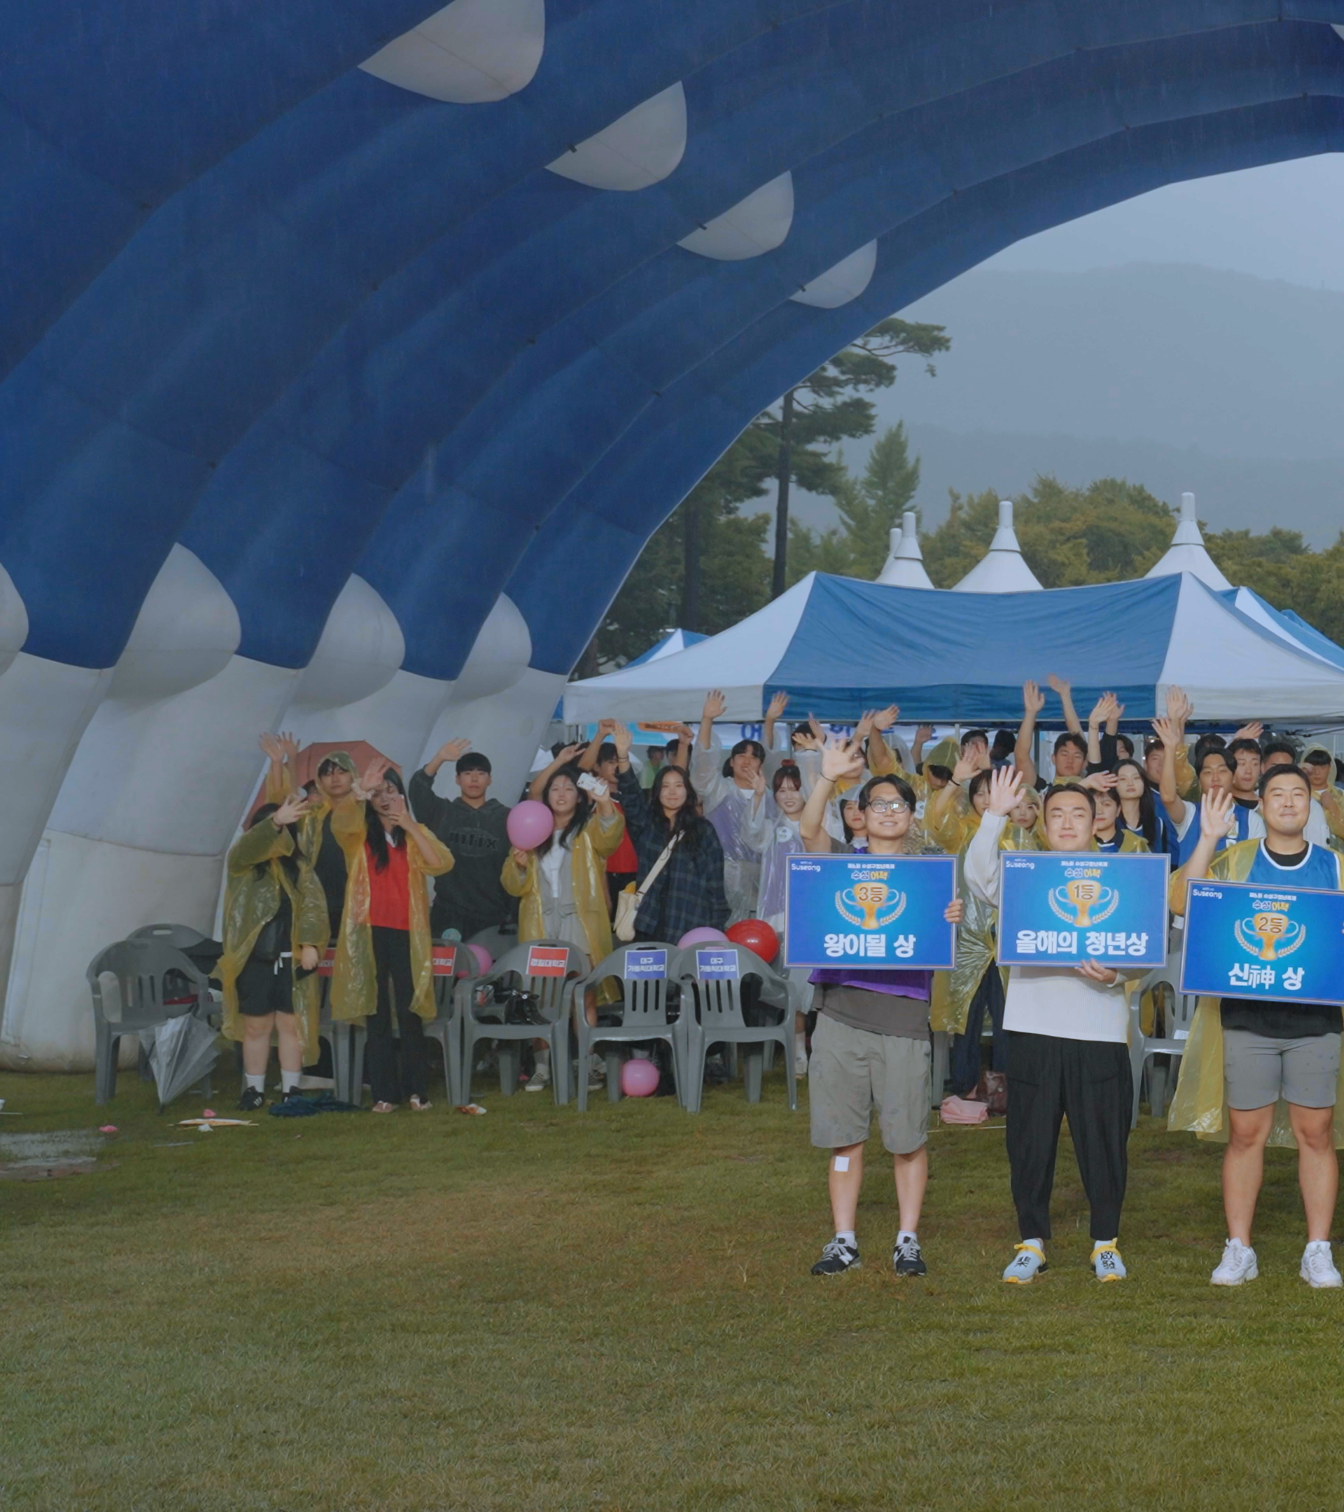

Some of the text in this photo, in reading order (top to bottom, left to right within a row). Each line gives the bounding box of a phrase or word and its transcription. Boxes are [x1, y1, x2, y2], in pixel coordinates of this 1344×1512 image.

[791, 863, 821, 872] Suseong
[1005, 861, 1035, 869] Suseong
[857, 886, 884, 903] 3등
[1073, 884, 1094, 900] 1등
[1193, 889, 1222, 899] Suseong
[1258, 916, 1283, 934] 2등
[824, 933, 916, 958] 왕이될 상
[1016, 930, 1148, 956] 올해의 청년상
[1228, 962, 1305, 990] 신神 상
